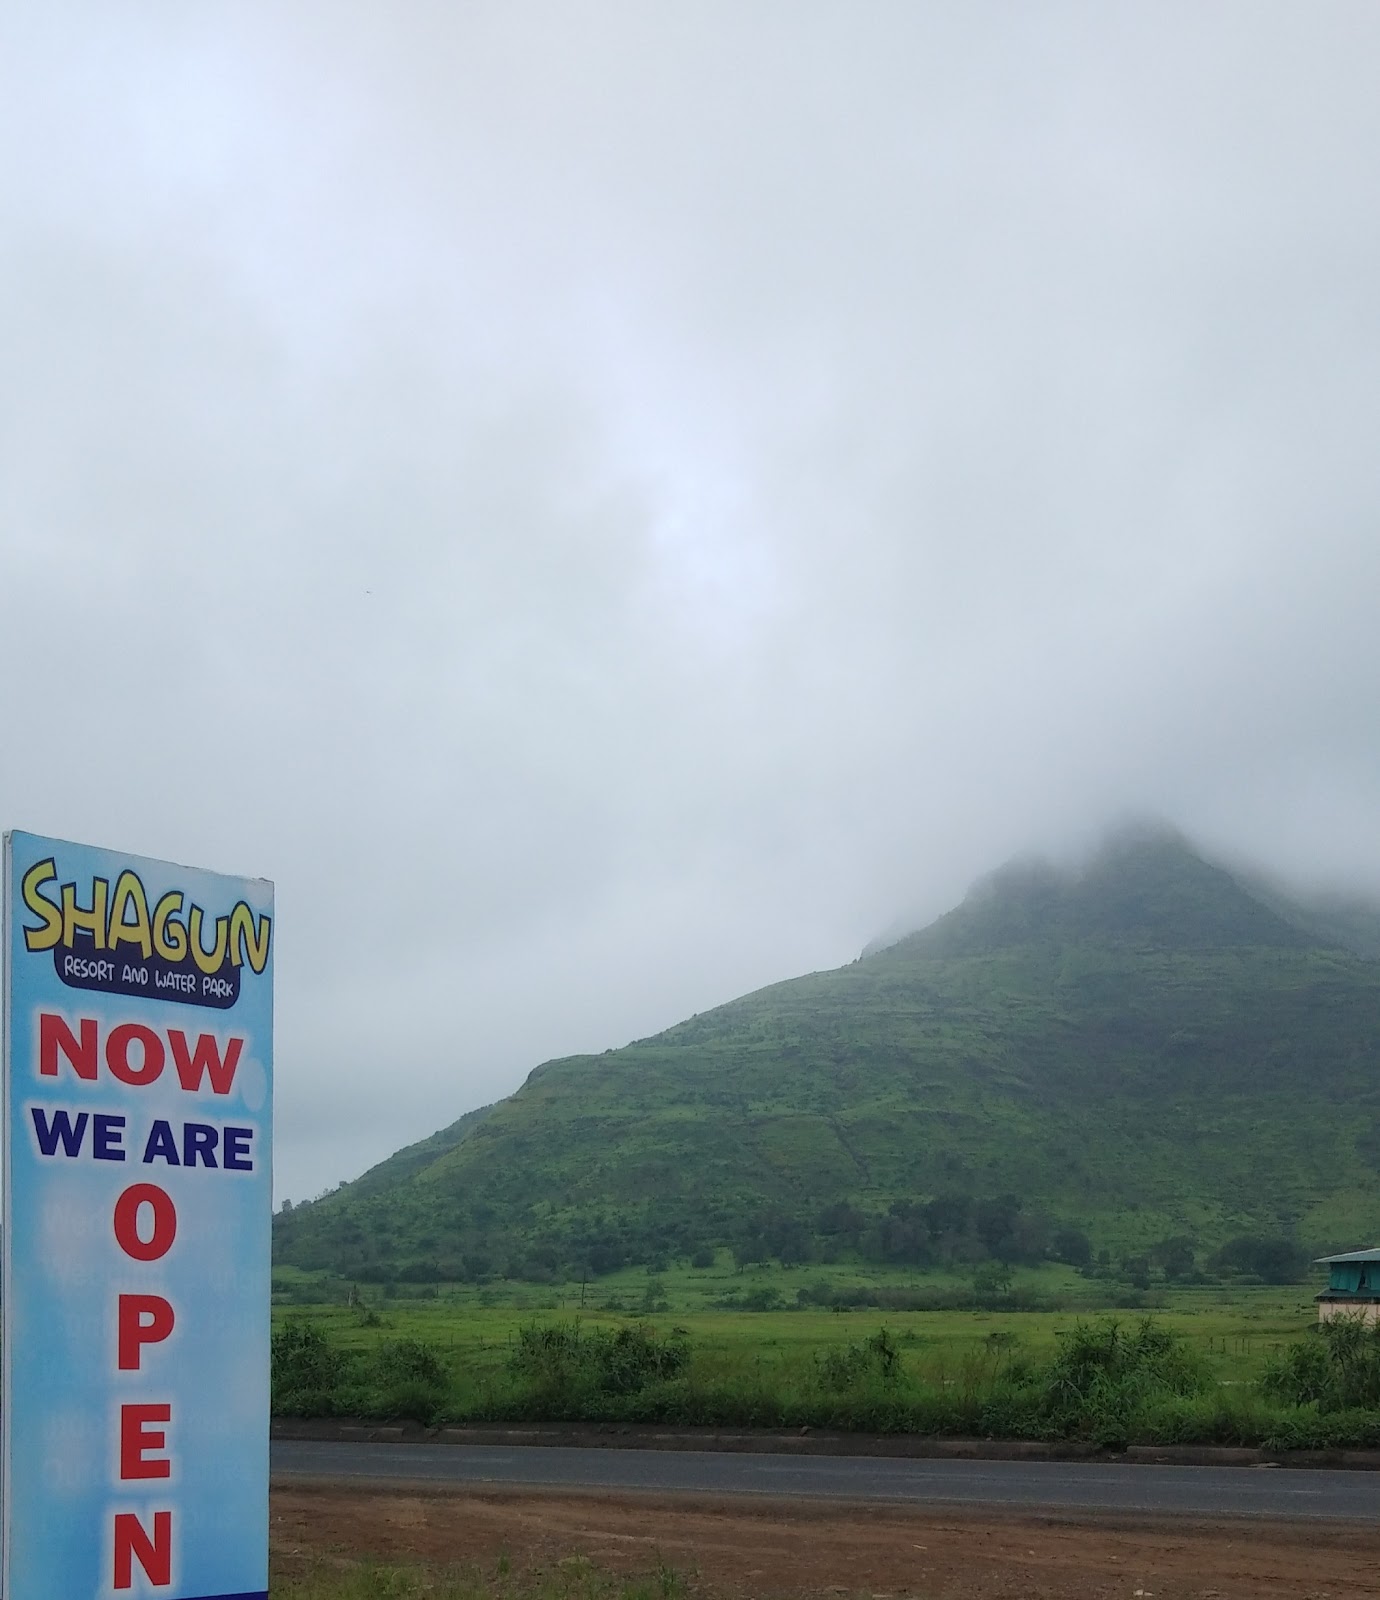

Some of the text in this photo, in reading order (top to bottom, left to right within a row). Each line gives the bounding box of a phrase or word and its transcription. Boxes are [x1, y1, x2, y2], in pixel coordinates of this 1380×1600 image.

[21, 857, 271, 975] SHAGUN
[64, 955, 233, 998] RESORT AND WATER PARK
[40, 1013, 244, 1095] NOW
[31, 1108, 253, 1171] WE ARE
